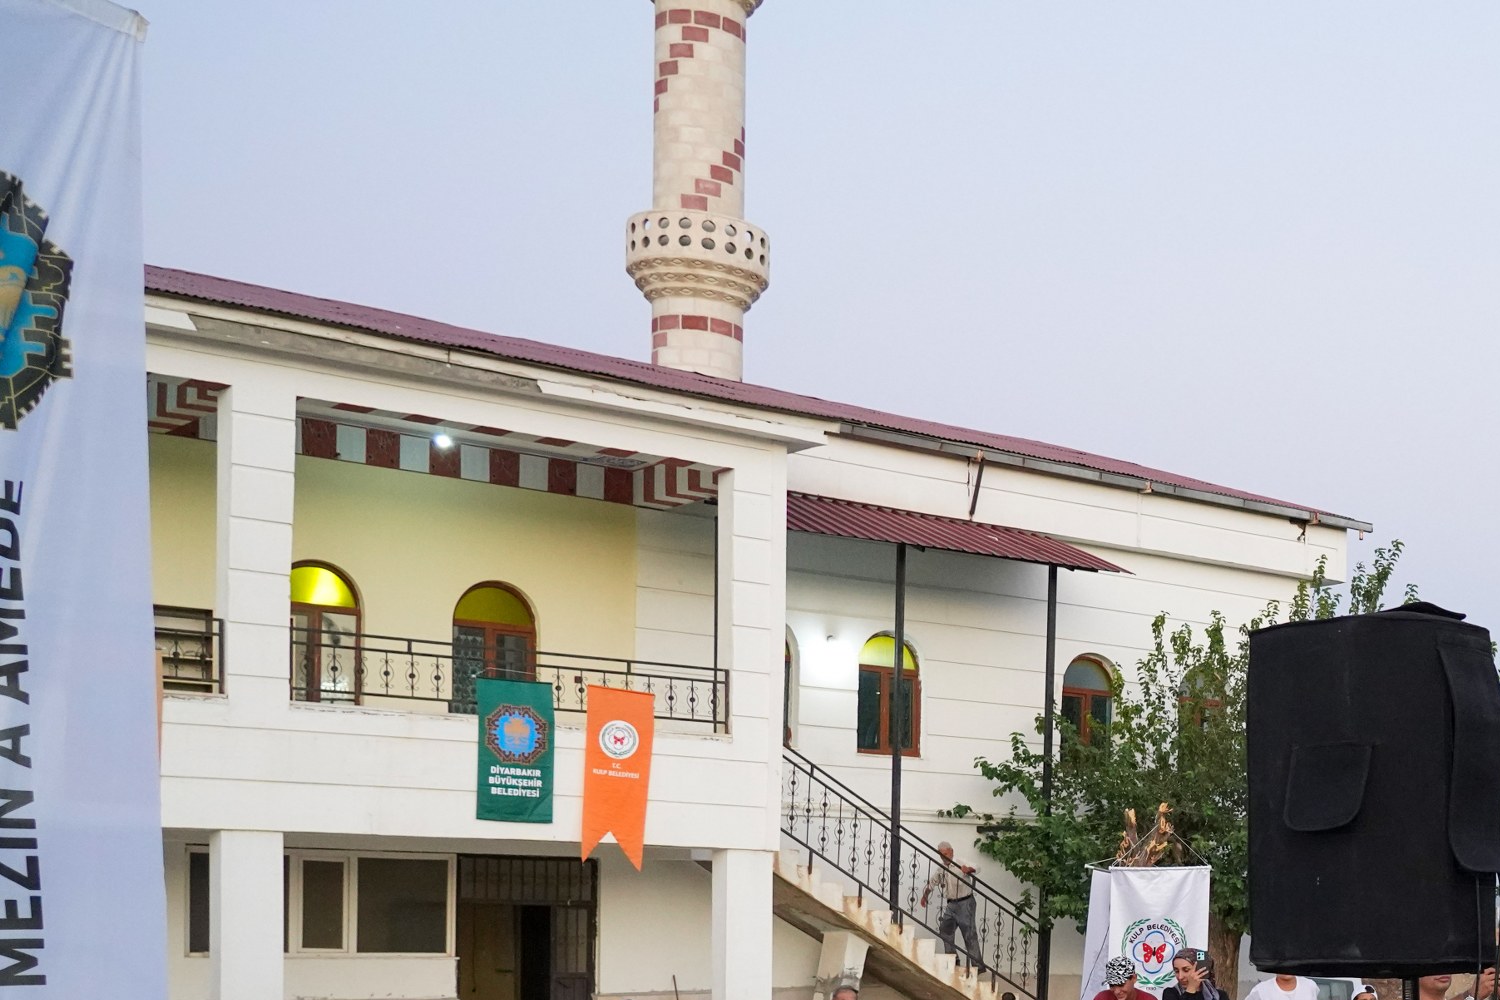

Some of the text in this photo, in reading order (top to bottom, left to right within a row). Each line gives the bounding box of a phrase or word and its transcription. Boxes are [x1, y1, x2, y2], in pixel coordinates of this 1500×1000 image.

[490, 764, 542, 778] DİYARBAKIR
[488, 775, 543, 789] BÜYÜKŞEHİR
[490, 786, 540, 798] BELEDİYESİ
[1128, 923, 1182, 946] KULP BELEDİYESİ
